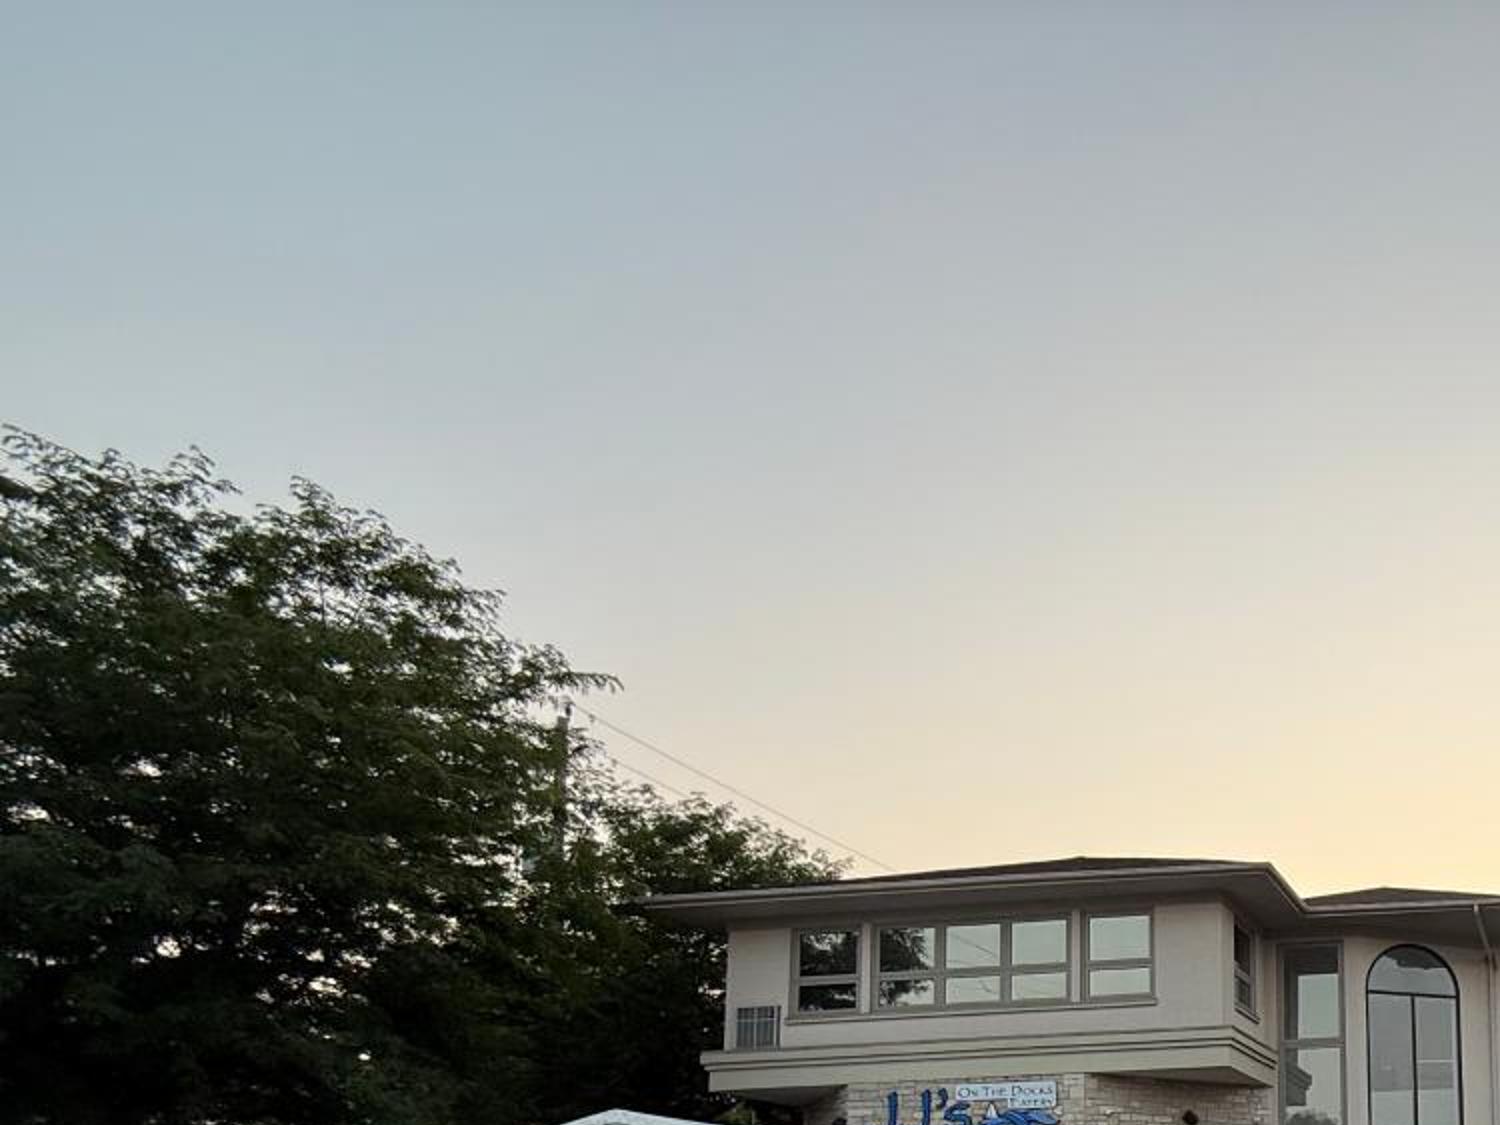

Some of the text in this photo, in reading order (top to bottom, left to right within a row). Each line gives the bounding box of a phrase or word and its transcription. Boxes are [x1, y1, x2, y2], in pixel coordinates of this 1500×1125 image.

[958, 1084, 1053, 1098] ON THE DOCKS
